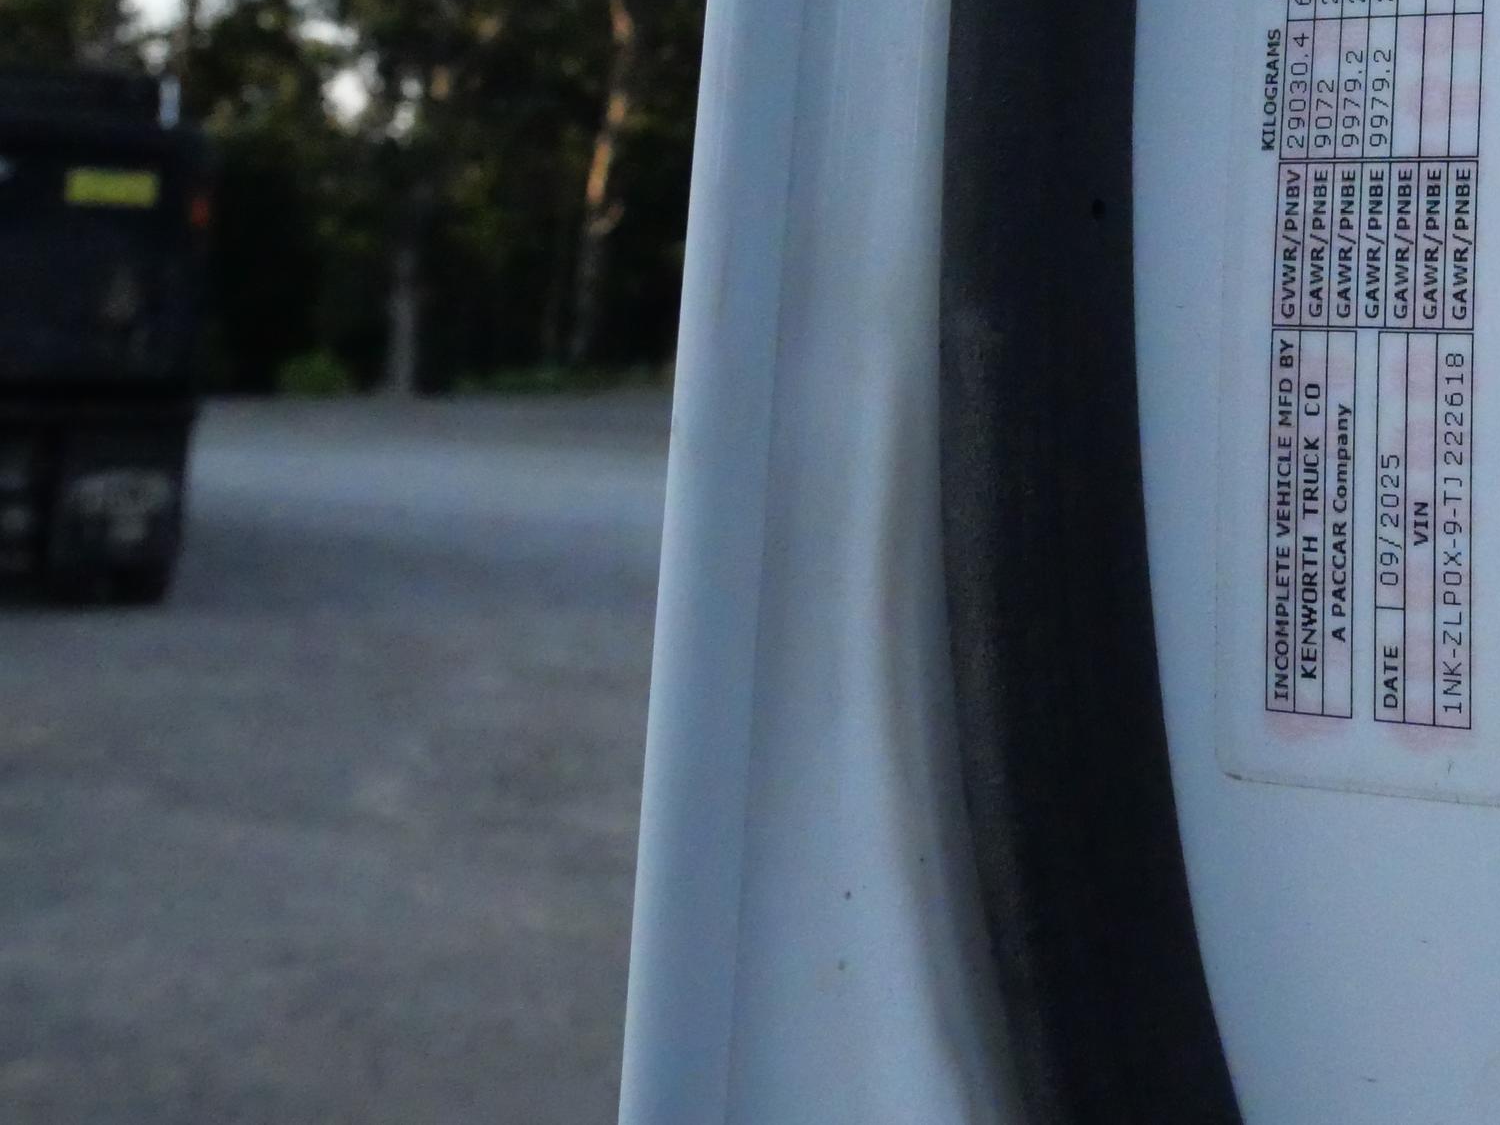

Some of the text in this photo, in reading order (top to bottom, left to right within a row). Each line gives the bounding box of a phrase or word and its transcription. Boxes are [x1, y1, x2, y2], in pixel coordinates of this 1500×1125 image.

[1261, 28, 1281, 151] KILOGRAMS
[1287, 32, 1310, 149] 29030.4
[1315, 78, 1334, 148] 9072
[1341, 49, 1363, 148] 9979.2
[1369, 47, 1392, 147] 9979.2
[1281, 169, 1302, 320] GVWR/PNBV
[1308, 168, 1328, 320] GAWR/PNBE
[1336, 168, 1356, 320] GAWR/PNBE
[1364, 168, 1385, 320] GAWR/PNBE
[1392, 168, 1413, 320] GAWR/PNBE
[1421, 168, 1442, 320] GAWR/PNBE
[1451, 168, 1472, 320] GAWR/PNBE
[1273, 339, 1294, 701] INCOMPLETE VEHICLE MFD BY
[1301, 383, 1320, 680] KENWORTH TRUCK CO
[1331, 404, 1351, 643] A PACCAR Company
[1379, 452, 1402, 709] DATE 09/2025
[1412, 502, 1429, 546] VIN
